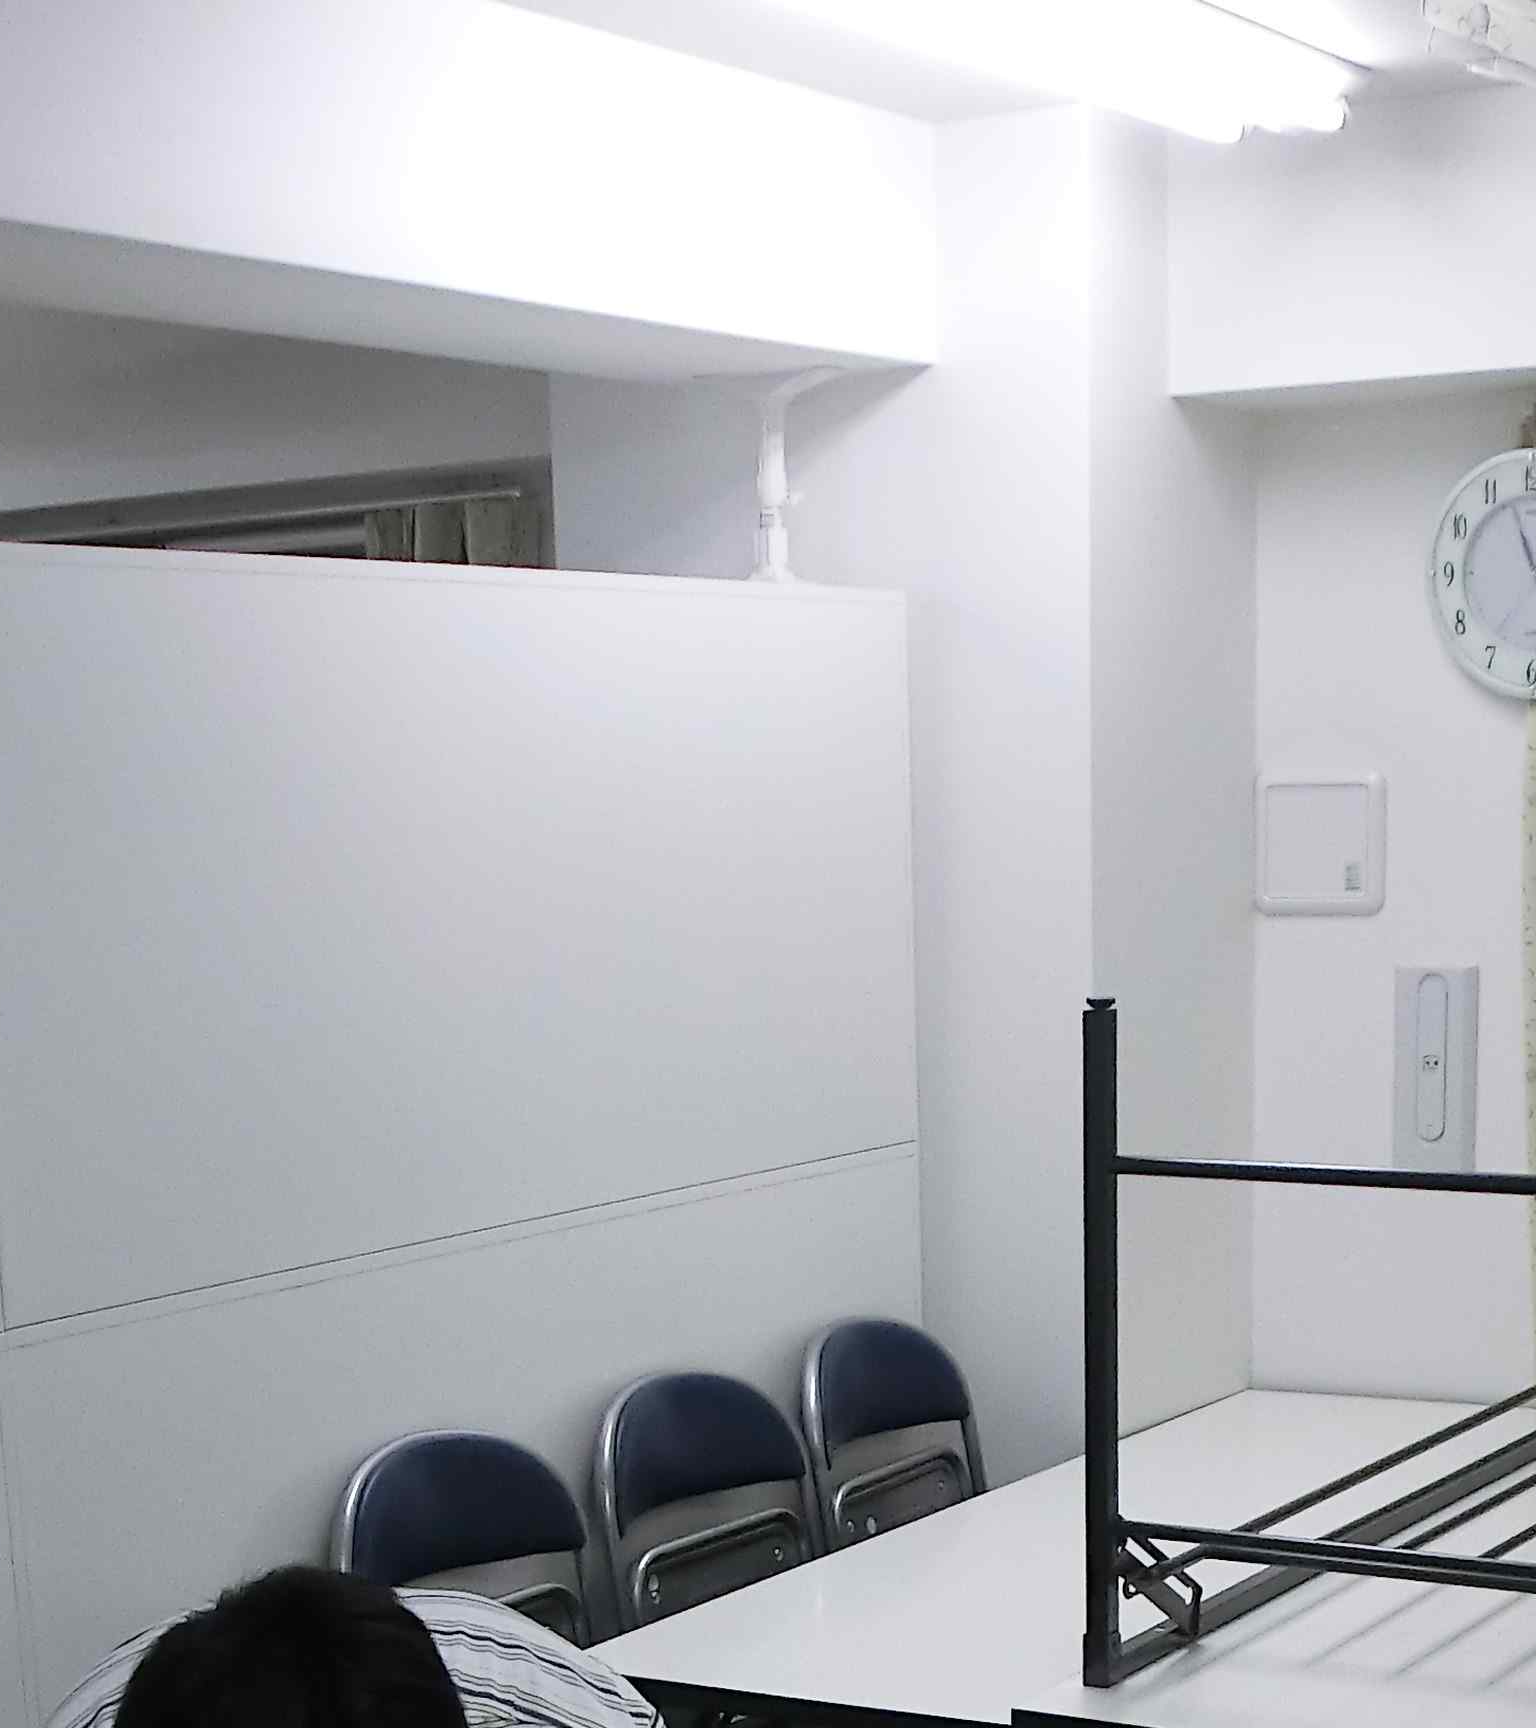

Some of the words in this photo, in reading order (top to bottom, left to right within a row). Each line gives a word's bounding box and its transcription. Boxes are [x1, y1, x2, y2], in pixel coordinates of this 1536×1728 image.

[1484, 478, 1497, 505] 11
[1452, 512, 1468, 540] 10
[1442, 560, 1455, 587] 9
[1453, 608, 1466, 635] 8
[1484, 644, 1497, 669] 7
